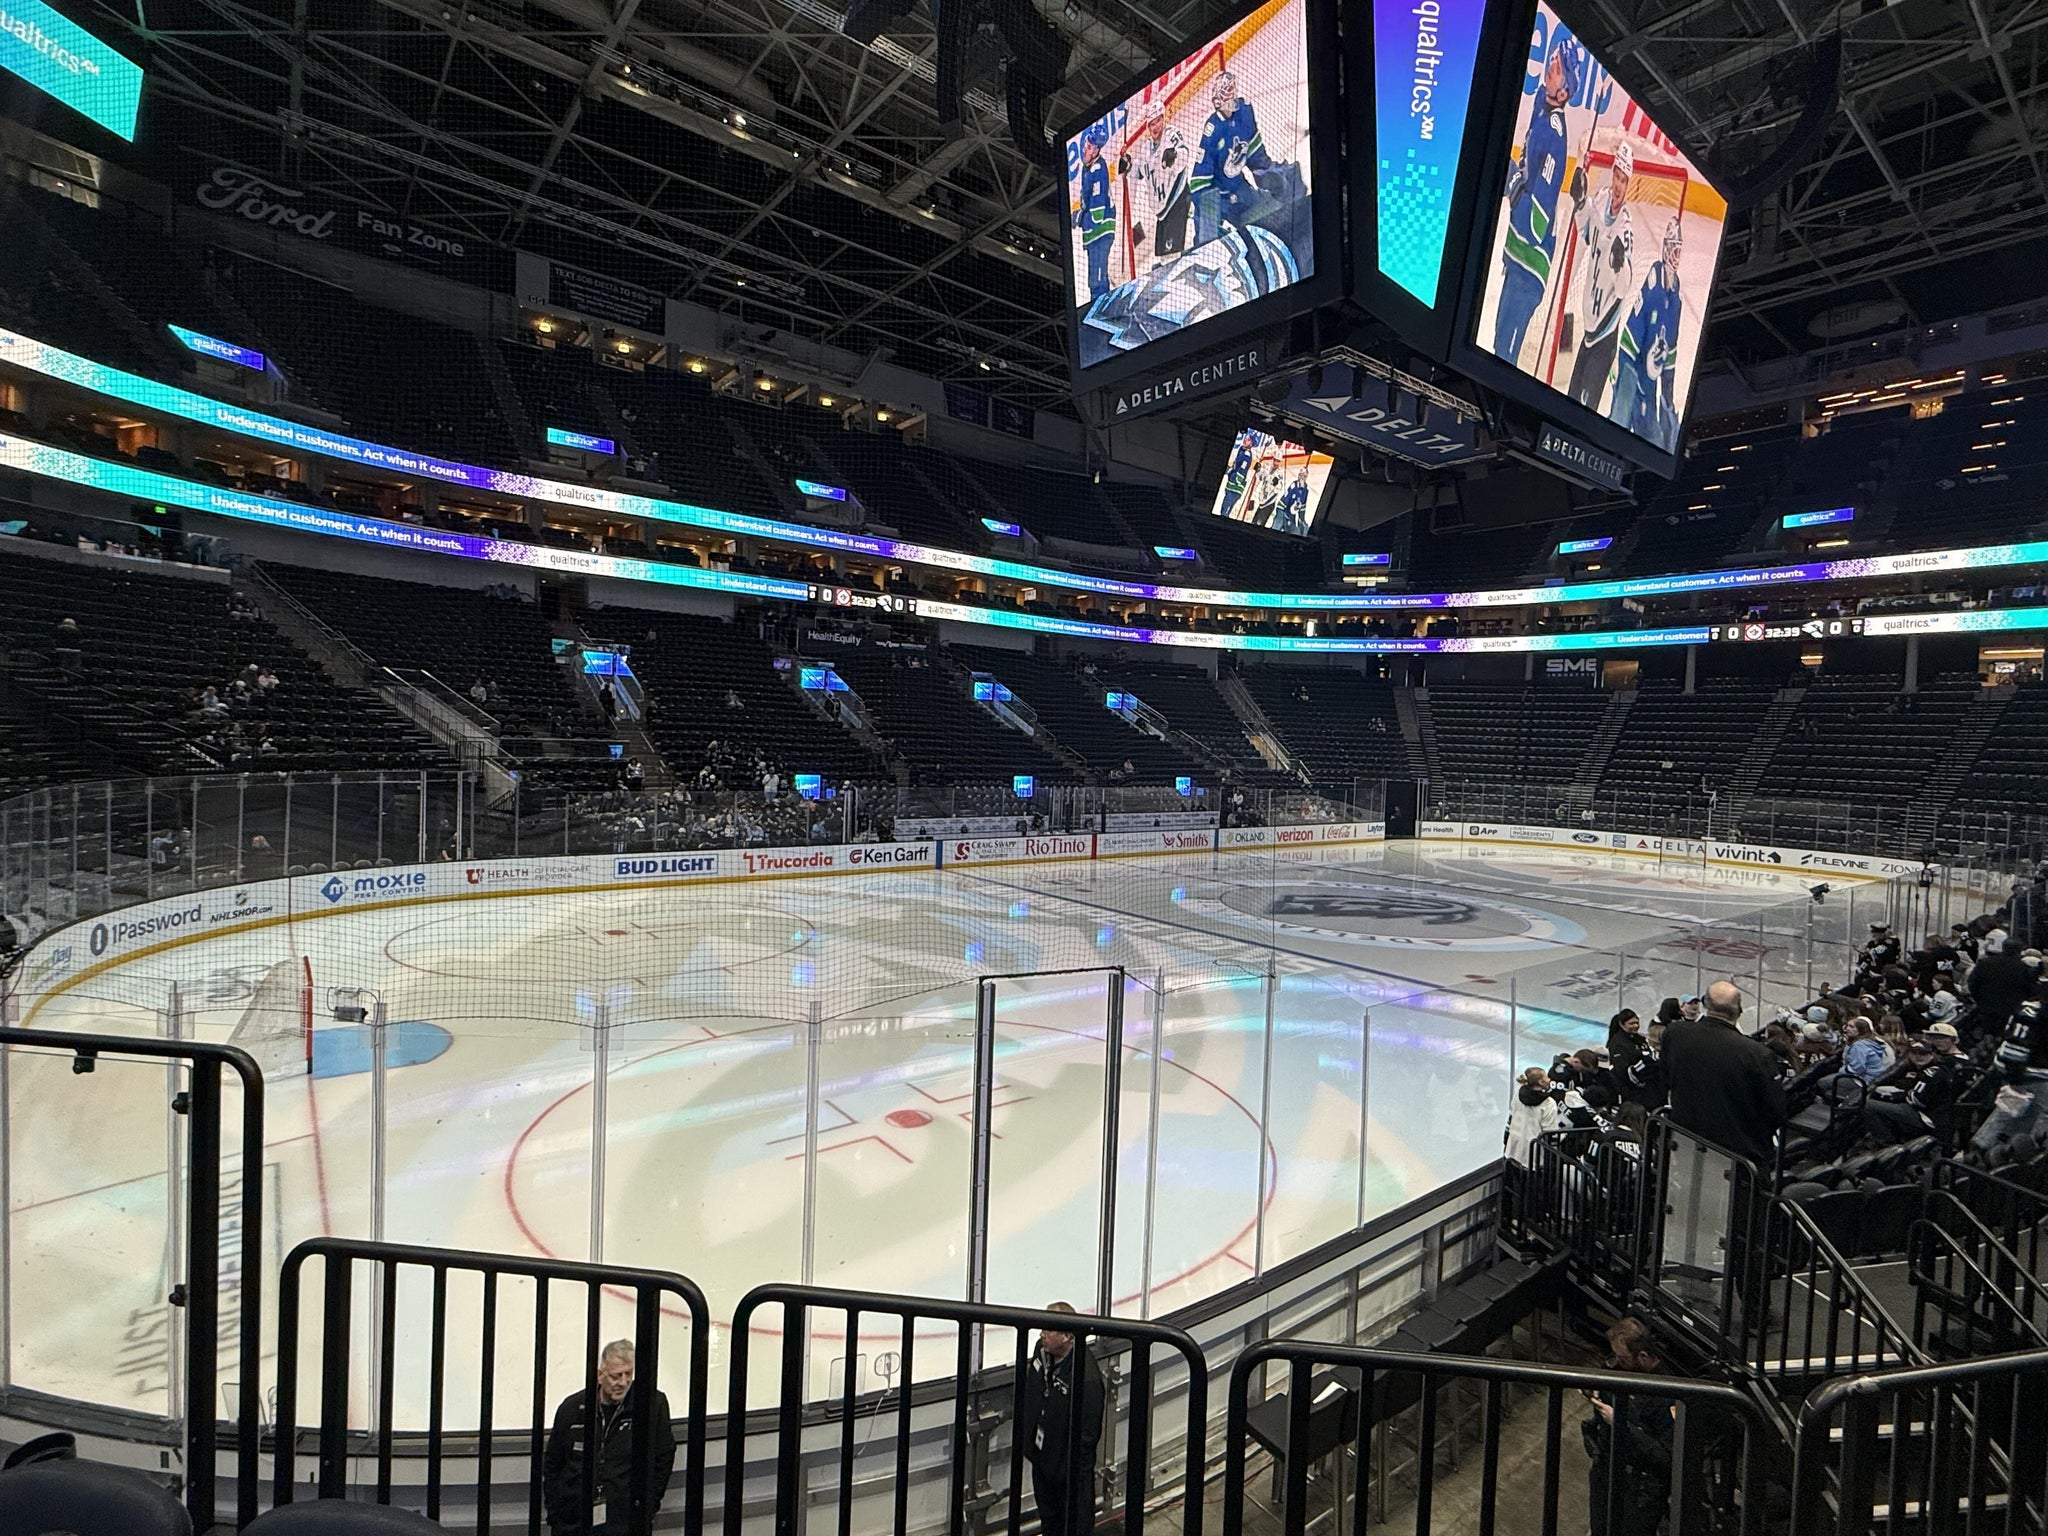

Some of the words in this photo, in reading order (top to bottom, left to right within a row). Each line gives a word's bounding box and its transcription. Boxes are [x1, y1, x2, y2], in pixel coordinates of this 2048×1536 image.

[197, 168, 337, 238] Ford
[357, 210, 402, 238] Fan
[408, 225, 465, 257] Zone
[1131, 377, 1184, 408] DELTA
[1190, 351, 1259, 388] CENTER
[1346, 407, 1467, 455] DELTA
[217, 409, 294, 439] Understand
[296, 430, 362, 456] customers.
[363, 448, 384, 461] Act
[386, 453, 417, 470] when
[419, 459, 428, 471] it
[429, 464, 470, 480] counts.
[1552, 436, 1587, 466] DELTA
[1587, 450, 1623, 483] CENTER
[211, 494, 287, 520] Understand
[289, 512, 355, 533] customers.
[357, 523, 378, 537] Act
[380, 528, 411, 542] when
[413, 532, 422, 544] it
[423, 537, 464, 551] counts.
[725, 516, 772, 534] Understand
[773, 527, 813, 542] customers.
[814, 532, 828, 542] Act
[828, 535, 848, 546] when
[848, 538, 854, 547] it
[855, 541, 880, 550] counts.
[1623, 582, 1669, 593] Understand
[1670, 578, 1718, 588] customers.
[1718, 575, 1734, 584] Act
[1736, 572, 1760, 582] when
[1762, 571, 1769, 580] it
[1770, 570, 1806, 580] counts.
[720, 576, 767, 591] Understand
[822, 588, 832, 602] 0
[895, 597, 903, 611] 0
[807, 630, 862, 647] HealthEquity
[1617, 632, 1663, 643] Understand
[1664, 630, 1709, 641] customers
[1728, 627, 1739, 640] 0
[1765, 626, 1800, 638] 32:39
[1829, 621, 1842, 634] 0
[1546, 658, 1597, 672] SME
[1176, 833, 1209, 848] Smith's
[1235, 832, 1265, 844] OKLAND
[1277, 828, 1313, 842] verizon
[1575, 833, 1596, 843] Ford
[864, 848, 891, 864] Ken
[894, 846, 929, 862] Garff
[1654, 840, 1705, 854] DELTA
[1715, 844, 1765, 863] vivint
[617, 860, 660, 876] BUD
[662, 858, 714, 873] LIGHT
[757, 853, 833, 870] Trucordia
[1813, 856, 1869, 870] FILEVINE
[355, 872, 426, 891] moxie
[488, 868, 528, 879] HEALTH
[112, 904, 202, 944] 1Password
